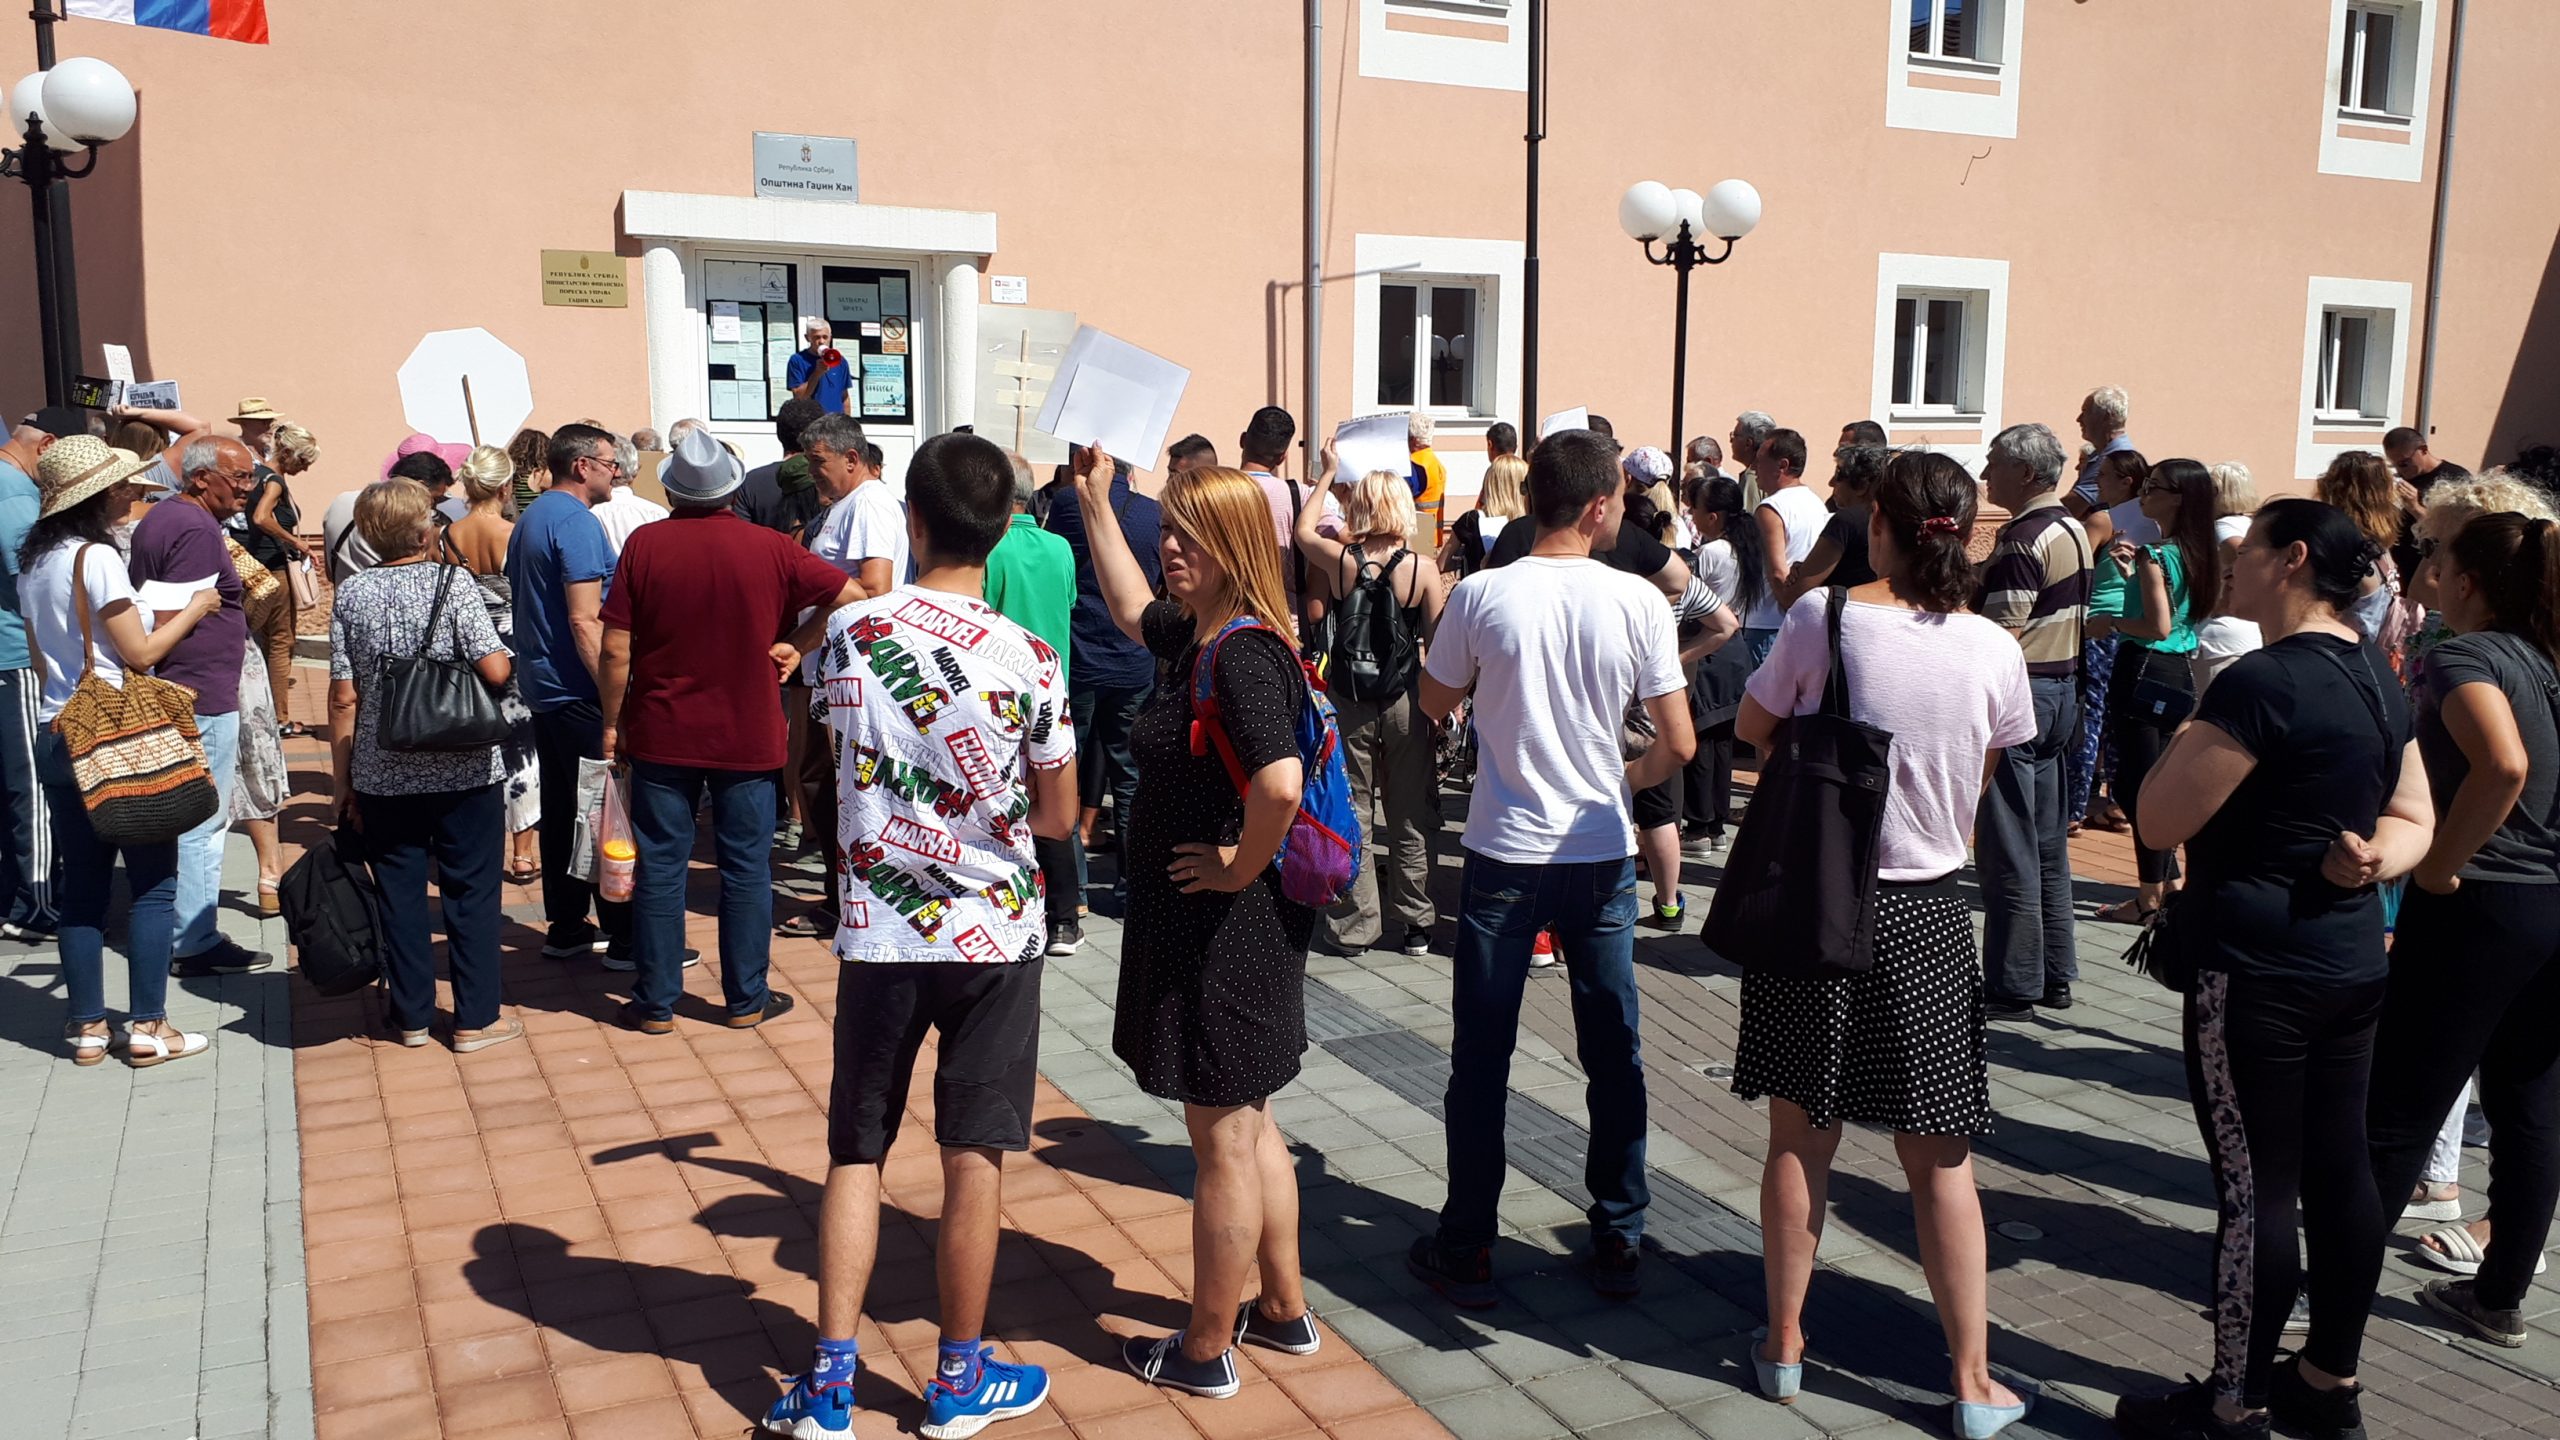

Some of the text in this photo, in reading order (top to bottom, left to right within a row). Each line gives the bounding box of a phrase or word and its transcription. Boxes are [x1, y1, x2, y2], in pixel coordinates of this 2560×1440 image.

[760, 177, 853, 192] Општина Гаџин Хан
[778, 163, 835, 175] Република Србија
[896, 601, 983, 649] MARVEL
[832, 629, 851, 674] MARVEL
[846, 608, 959, 736] MARVEL
[930, 645, 972, 697] MARVEL
[1030, 697, 1054, 745] MARVEL
[849, 738, 978, 831] MARVEL
[948, 730, 1006, 800] MARVEL
[882, 819, 958, 864] MARVEL
[849, 830, 963, 945] MARVEL
[922, 863, 969, 899] MARVEL
